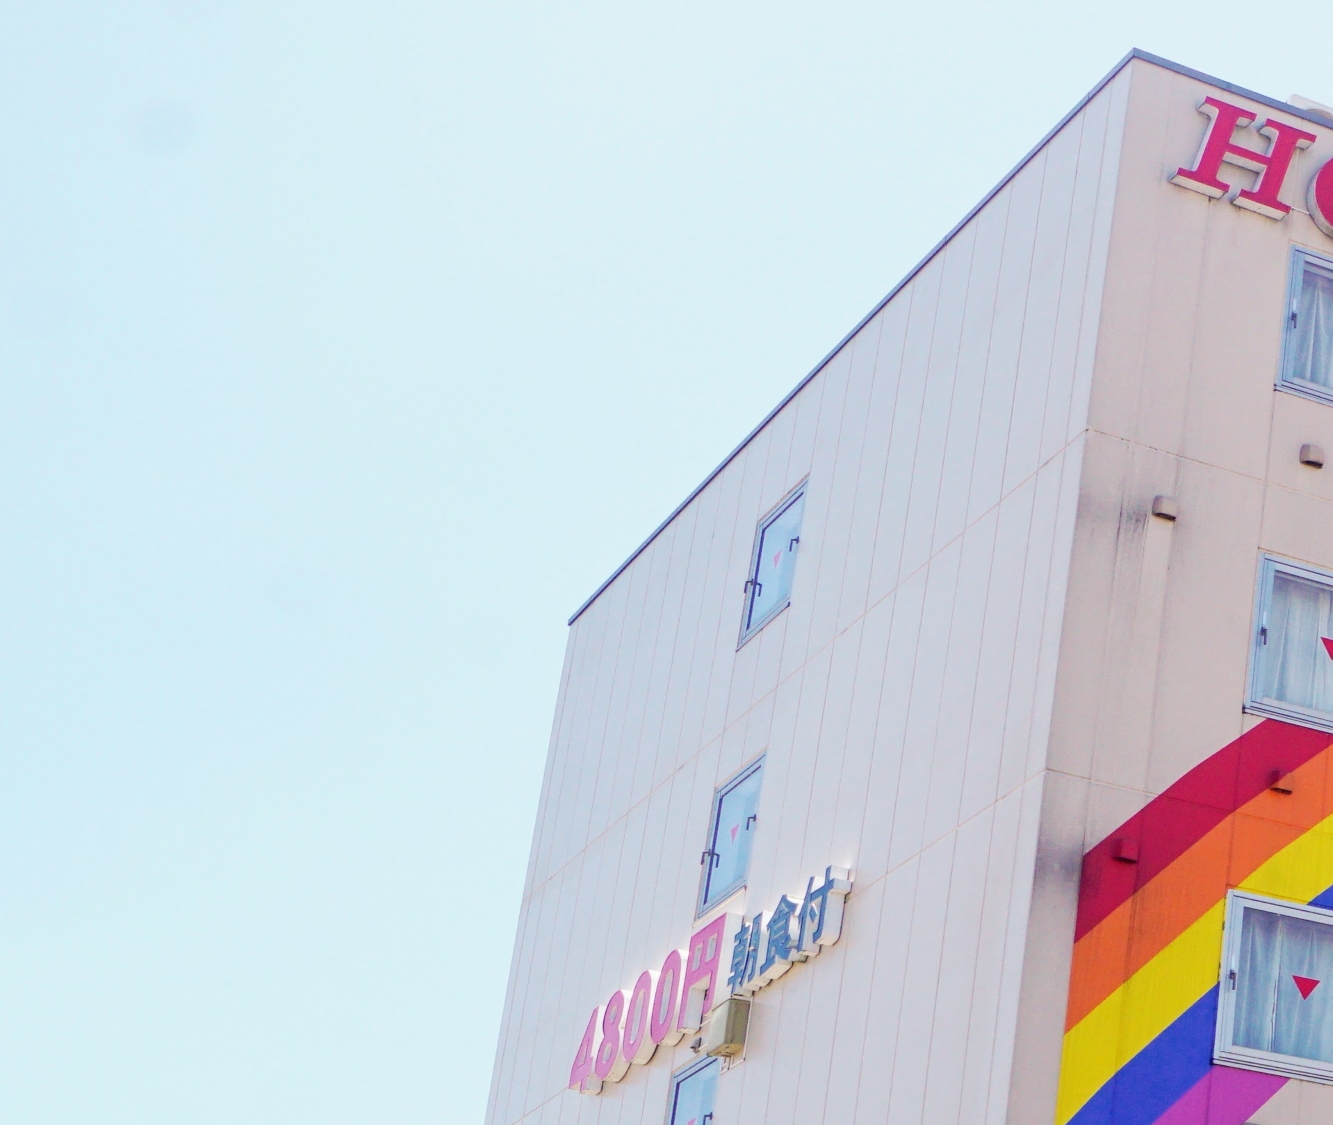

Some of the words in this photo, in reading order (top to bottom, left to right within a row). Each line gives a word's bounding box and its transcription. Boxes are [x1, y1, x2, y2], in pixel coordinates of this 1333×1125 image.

[569, 912, 736, 1095] 4800円
[728, 865, 852, 997] 朝食付
